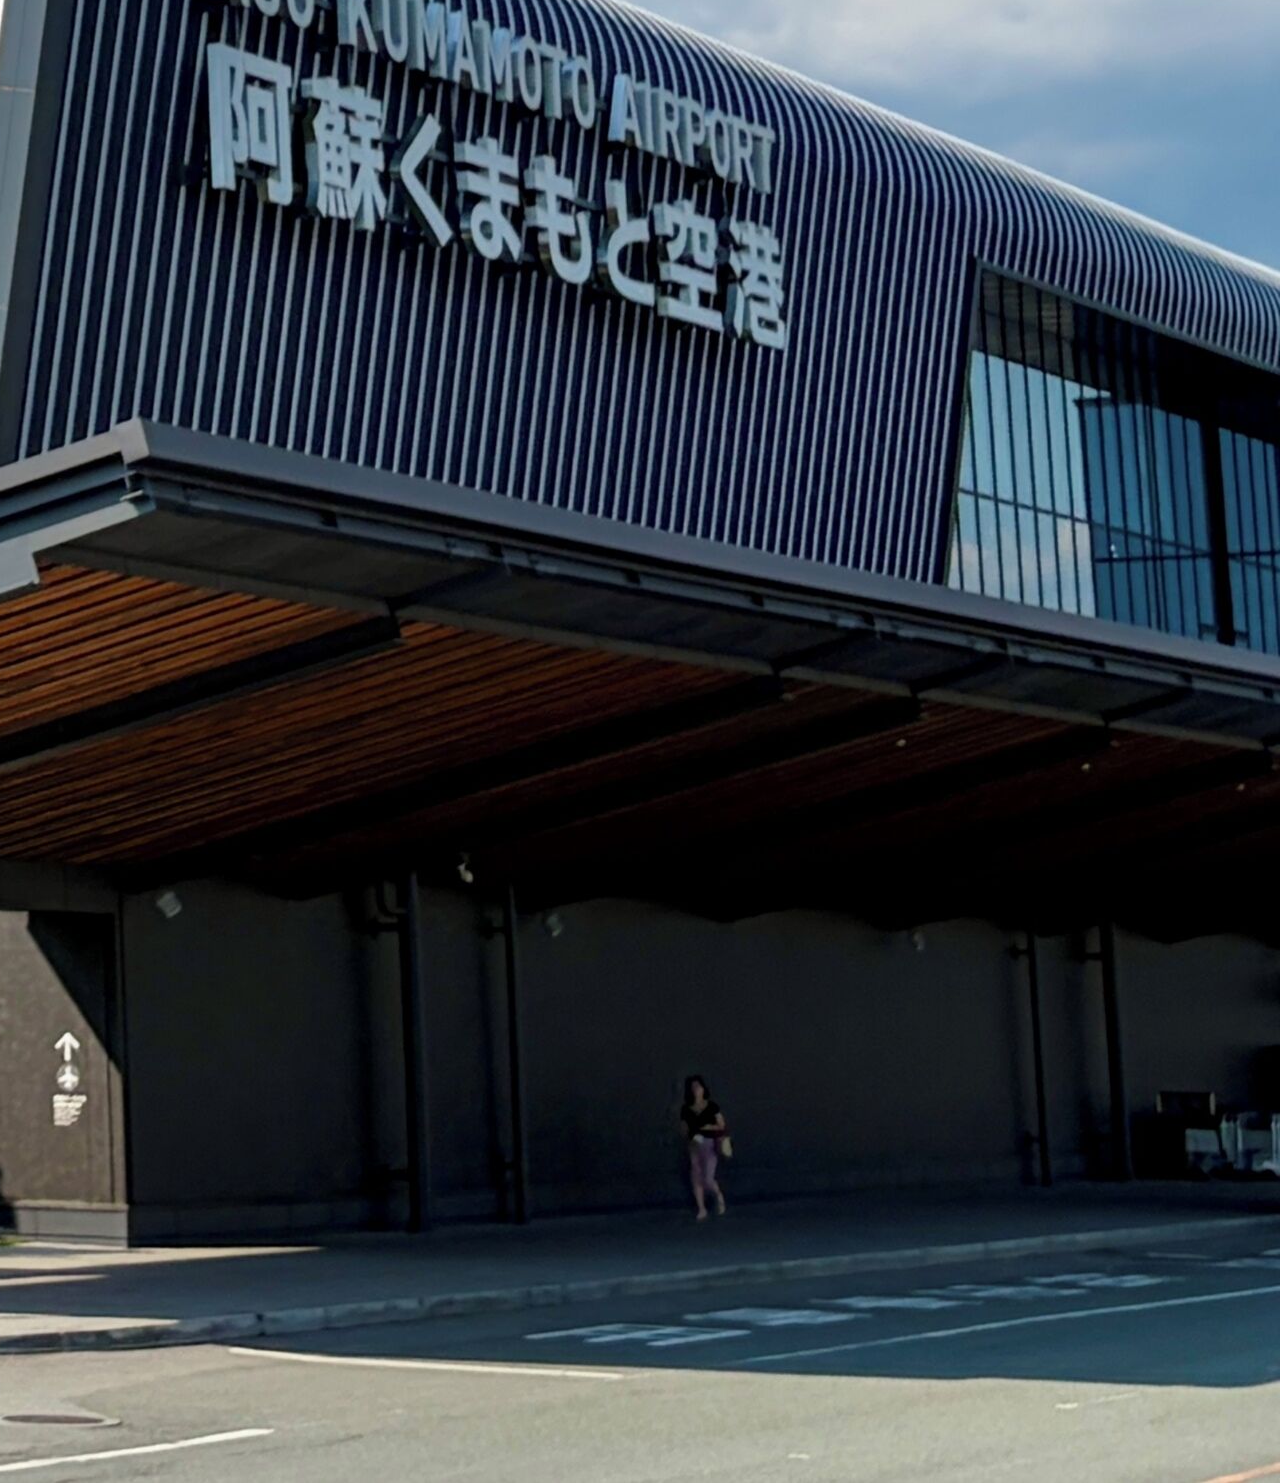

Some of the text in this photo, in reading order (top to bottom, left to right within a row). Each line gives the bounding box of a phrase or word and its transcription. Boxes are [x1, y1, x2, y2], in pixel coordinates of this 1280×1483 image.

[207, 42, 787, 350] 阿蘇くまもと空港
[609, 73, 777, 195] AIRPORT
